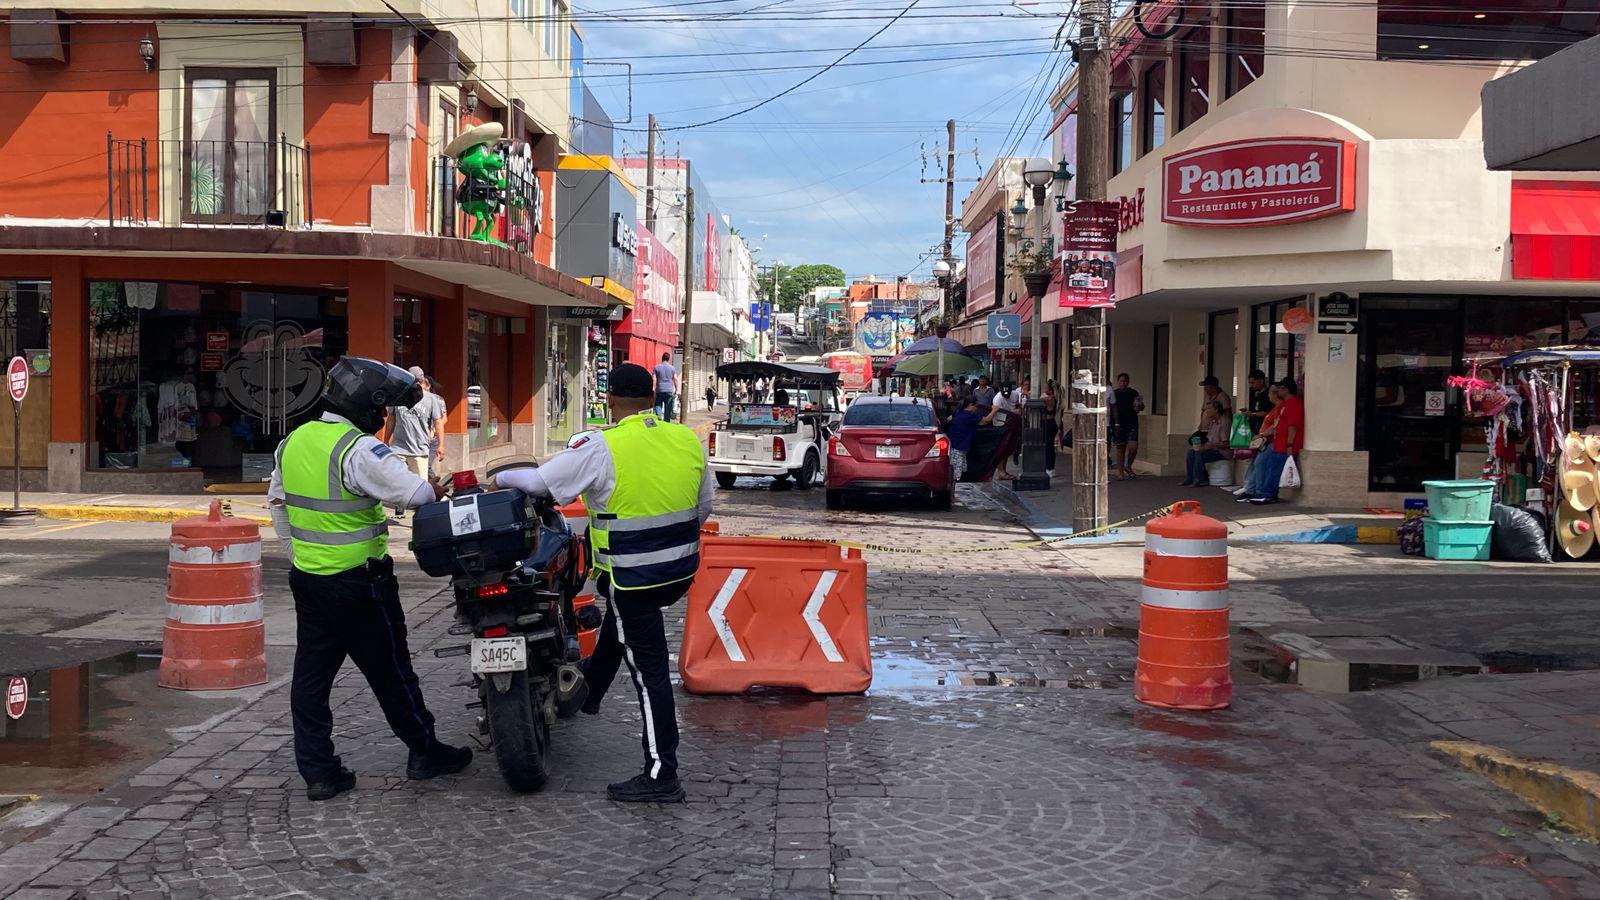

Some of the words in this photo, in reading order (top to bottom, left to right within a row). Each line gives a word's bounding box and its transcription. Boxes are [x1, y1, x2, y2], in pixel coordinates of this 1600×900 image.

[1178, 151, 1322, 195] Panamá
[1181, 199, 1248, 214] Restaurante
[1251, 200, 1257, 210] y
[1260, 194, 1320, 208] Pastelería
[480, 646, 517, 663] SA45C
